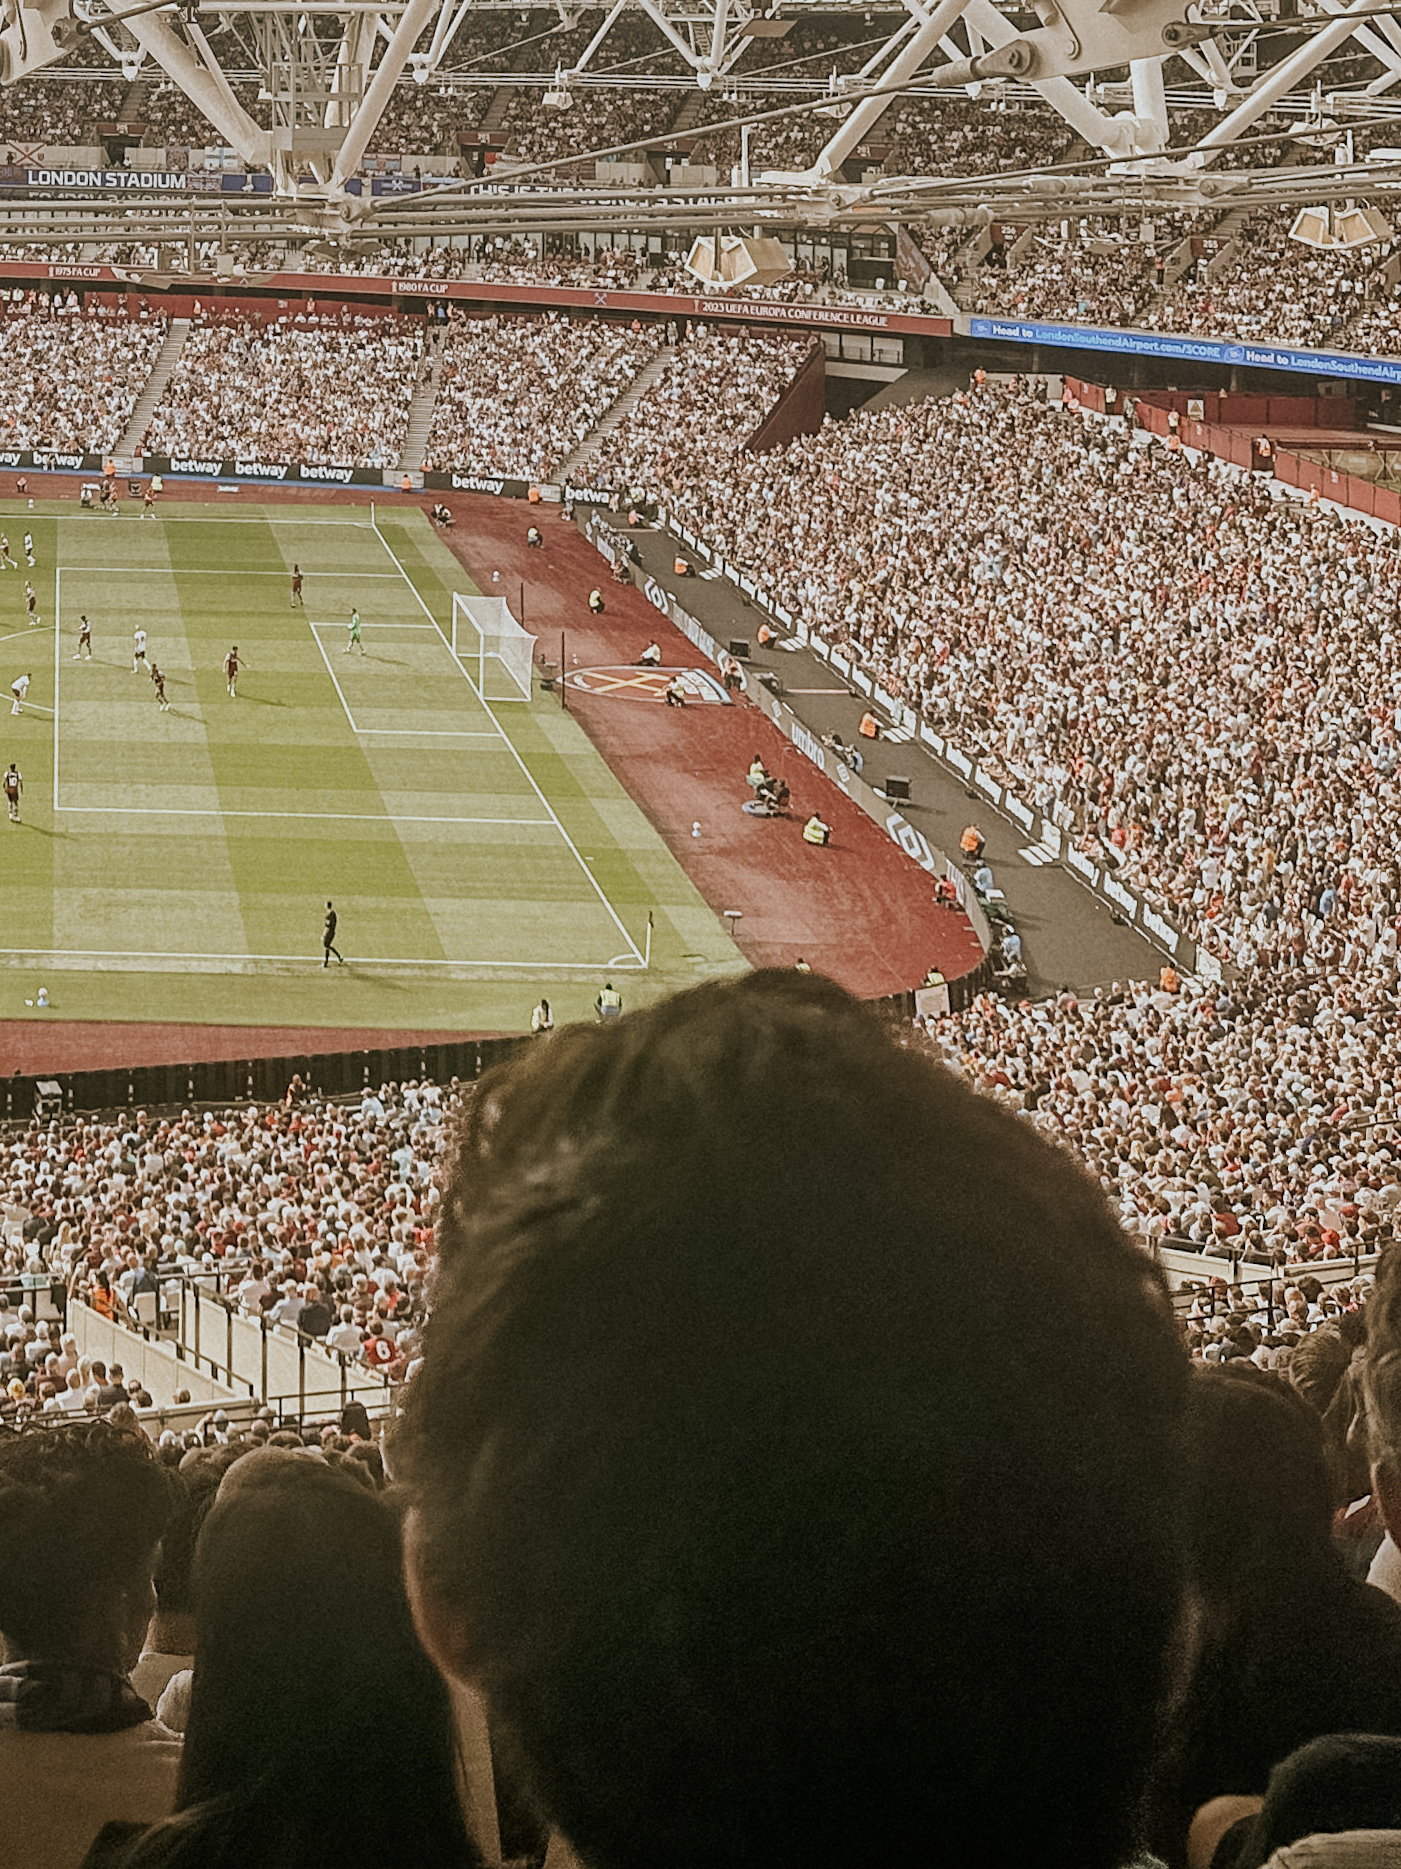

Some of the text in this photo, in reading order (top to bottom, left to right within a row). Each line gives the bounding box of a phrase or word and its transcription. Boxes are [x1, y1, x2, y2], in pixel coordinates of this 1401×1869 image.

[27, 170, 101, 187] LONDON
[105, 172, 186, 189] STADIUM
[72, 267, 83, 277] FA
[83, 267, 101, 278] CUP
[399, 282, 449, 294] 1980 FA CUP
[702, 301, 888, 326] 2023 UEFA EUROPA CONFERENCE LEAGUE
[992, 324, 1020, 337] Head
[1021, 327, 1034, 338] to
[1246, 350, 1275, 364] Head
[1276, 353, 1289, 366] to
[33, 451, 84, 470] beway
[170, 457, 223, 477] betway
[234, 460, 288, 480] betway
[299, 463, 354, 484] betway
[451, 473, 505, 495] betway
[565, 485, 610, 505] betwa
[791, 722, 825, 770] umbro
[375, 1340, 391, 1360] 6
